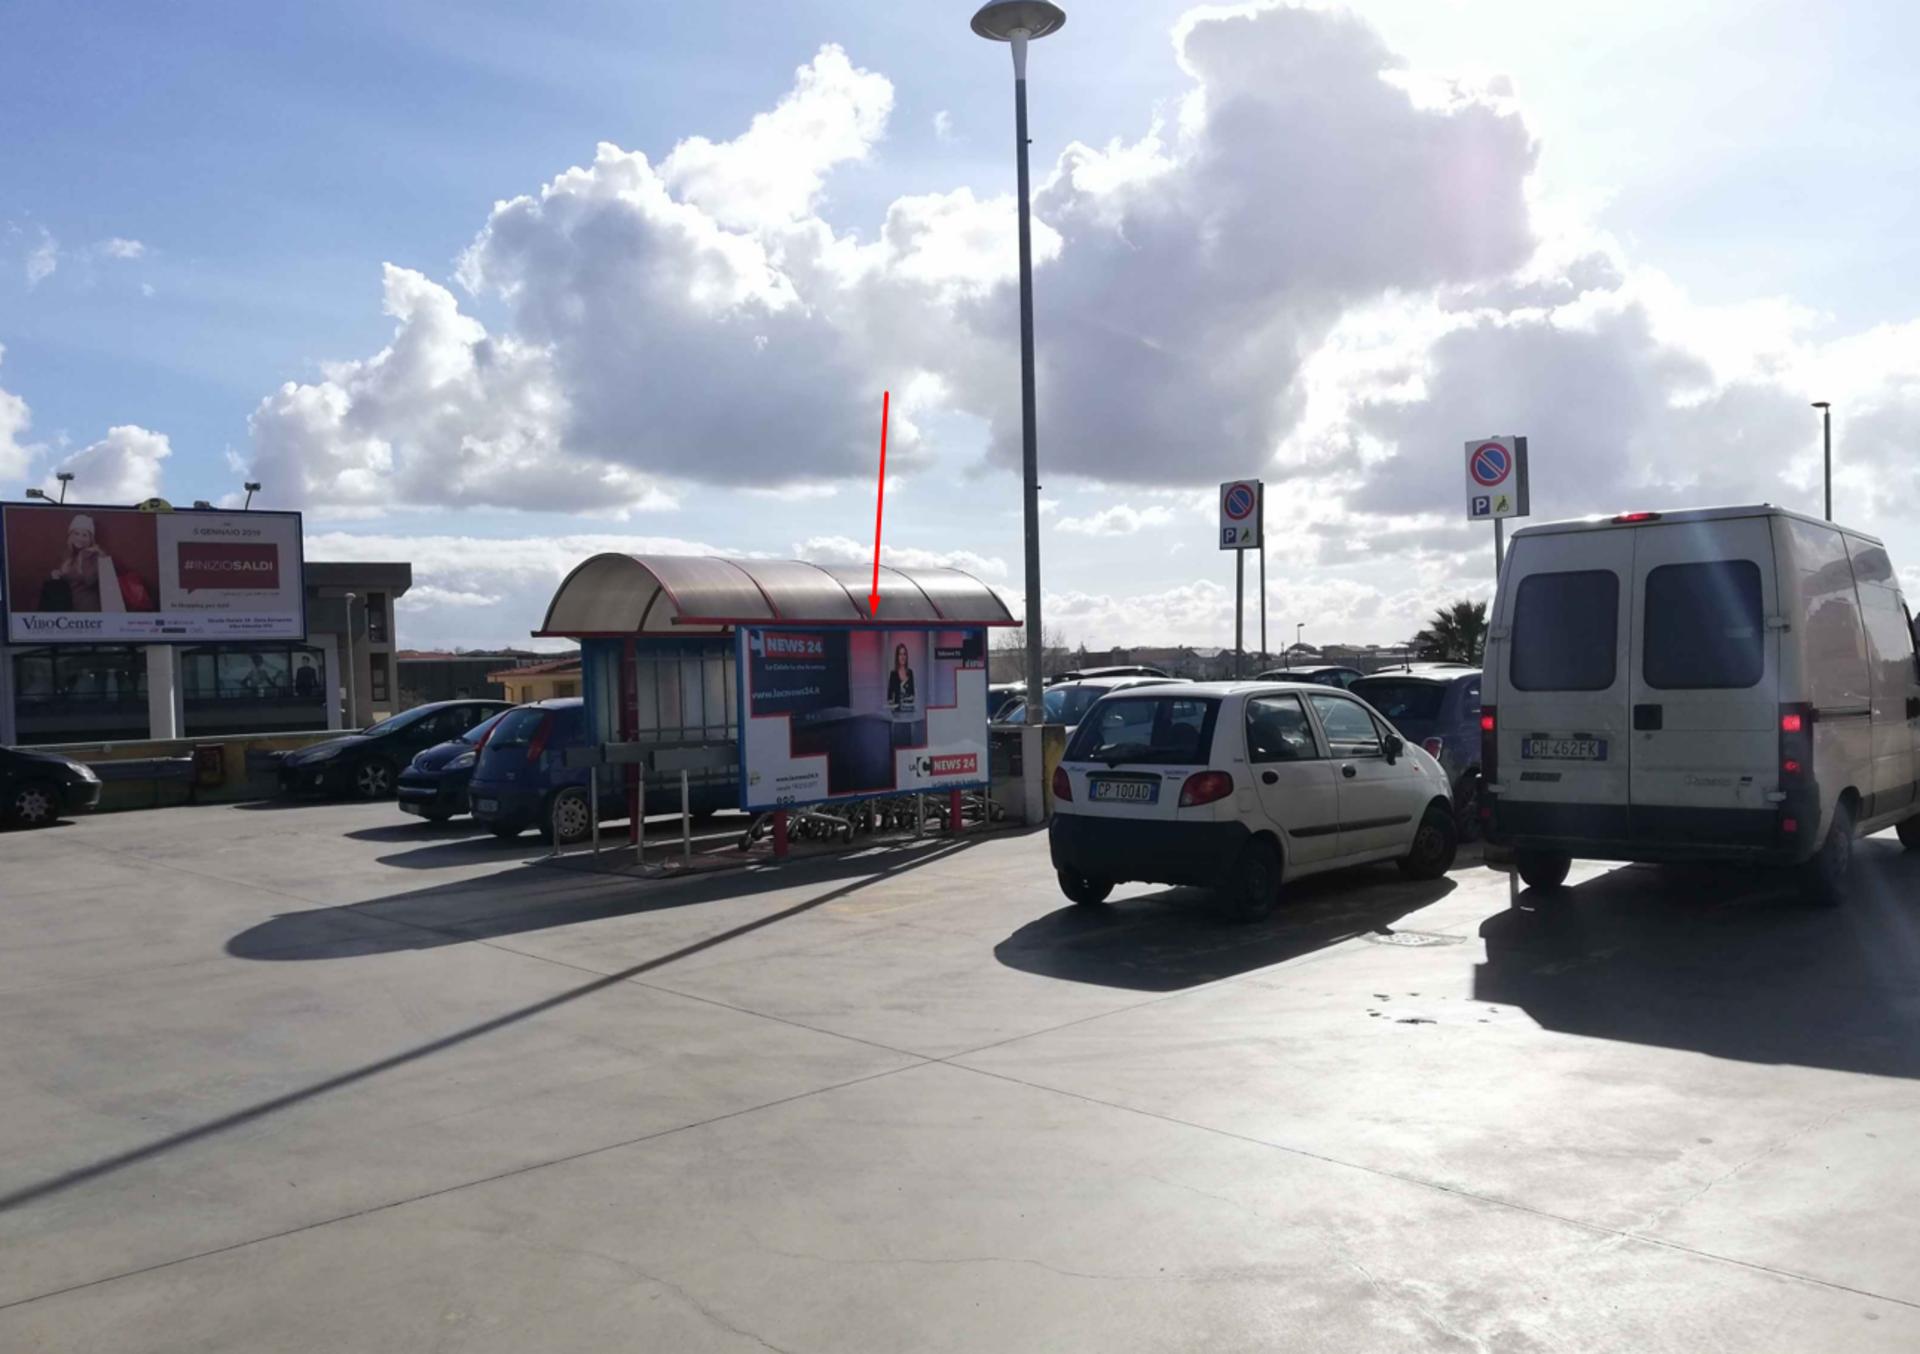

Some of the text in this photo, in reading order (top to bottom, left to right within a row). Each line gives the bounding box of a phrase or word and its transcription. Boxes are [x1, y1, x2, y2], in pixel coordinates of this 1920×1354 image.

[1476, 498, 1488, 514] P
[1225, 529, 1235, 542] P
[184, 559, 273, 571] #INIZIOSALDI
[767, 637, 823, 653] NEWS 24
[1531, 741, 1597, 756] CH 462FK
[934, 759, 961, 771] NEWS
[962, 758, 976, 769] 24
[1097, 782, 1112, 796] CP
